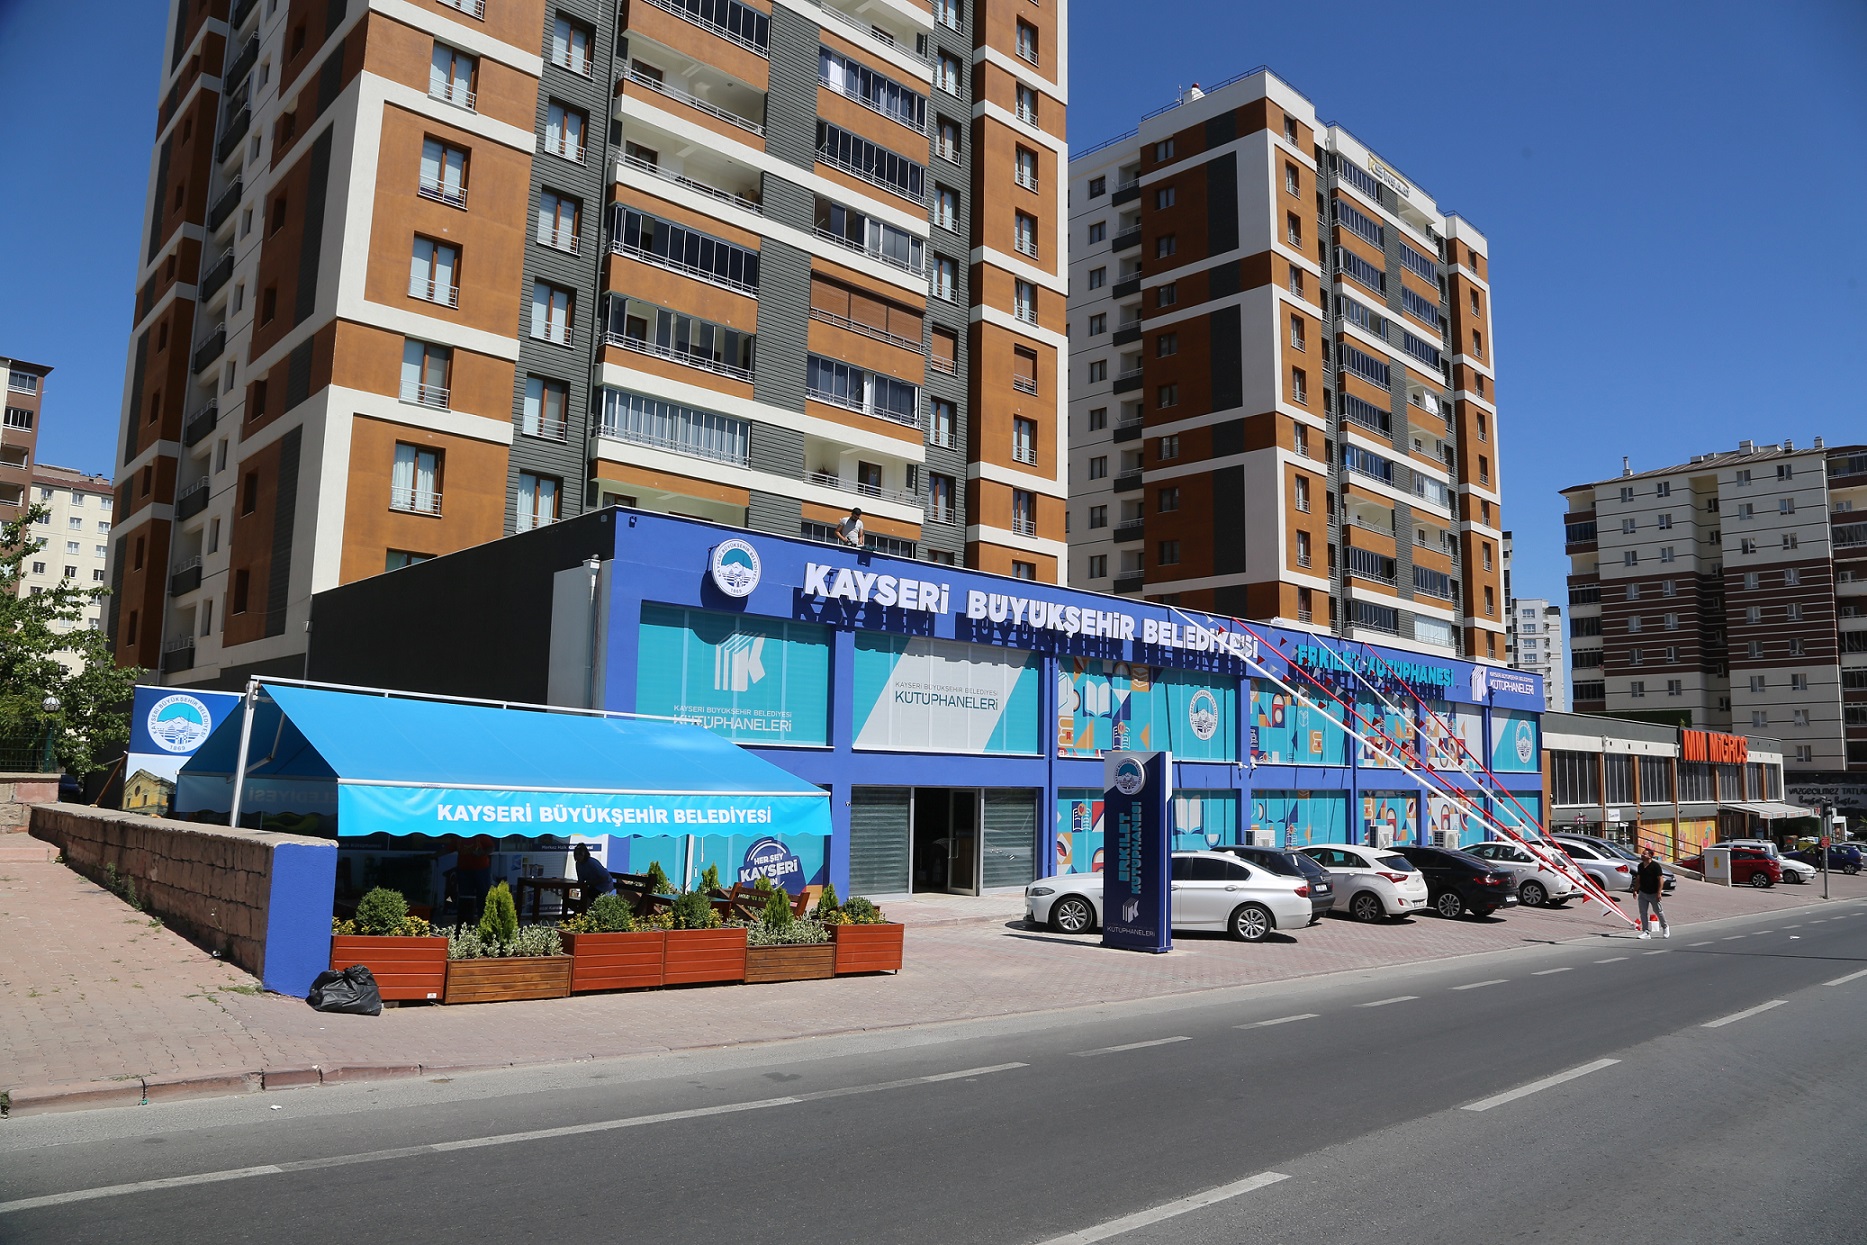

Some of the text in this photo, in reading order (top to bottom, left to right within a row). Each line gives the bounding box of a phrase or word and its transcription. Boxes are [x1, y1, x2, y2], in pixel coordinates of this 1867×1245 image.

[803, 562, 950, 615] KAYSERİ
[966, 589, 1135, 641] BÜYÜKŞEHİR
[895, 682, 998, 696] KAYSERİ BÜYÜKŞEHİR BELEDİYESİ
[674, 705, 792, 718] KAYSERİ BÜYÜKŞEHİR BELEDİYESİ
[895, 690, 998, 711] KÜTÜPHANELERİ
[1683, 729, 1707, 762] MM
[437, 803, 771, 827] KAYSERİ BÜYÜKŞEHİR BELEDİYESİ
[754, 853, 784, 865] HER ŞEY
[740, 859, 799, 883] KAYSERİ
